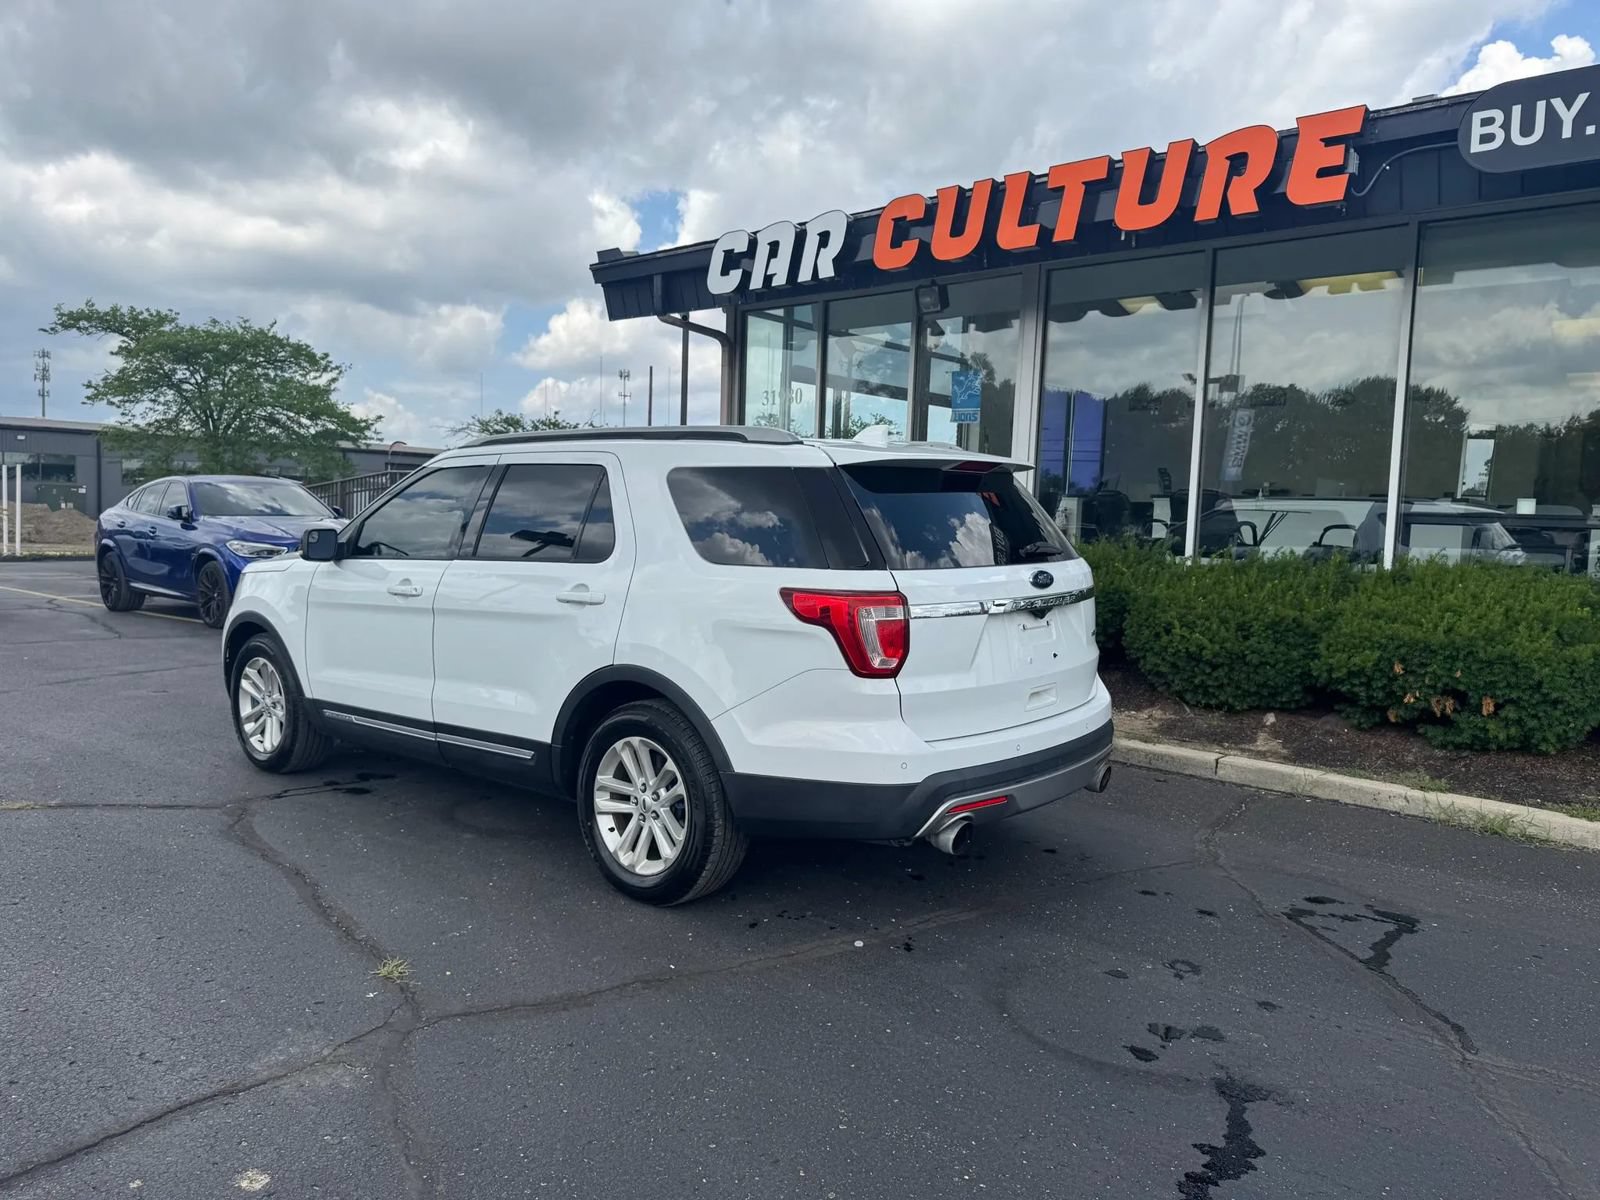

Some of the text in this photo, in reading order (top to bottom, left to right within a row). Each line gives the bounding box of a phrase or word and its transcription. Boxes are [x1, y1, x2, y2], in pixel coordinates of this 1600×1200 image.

[1470, 92, 1596, 153] BUY.
[707, 105, 1366, 295] CAR CULTURE
